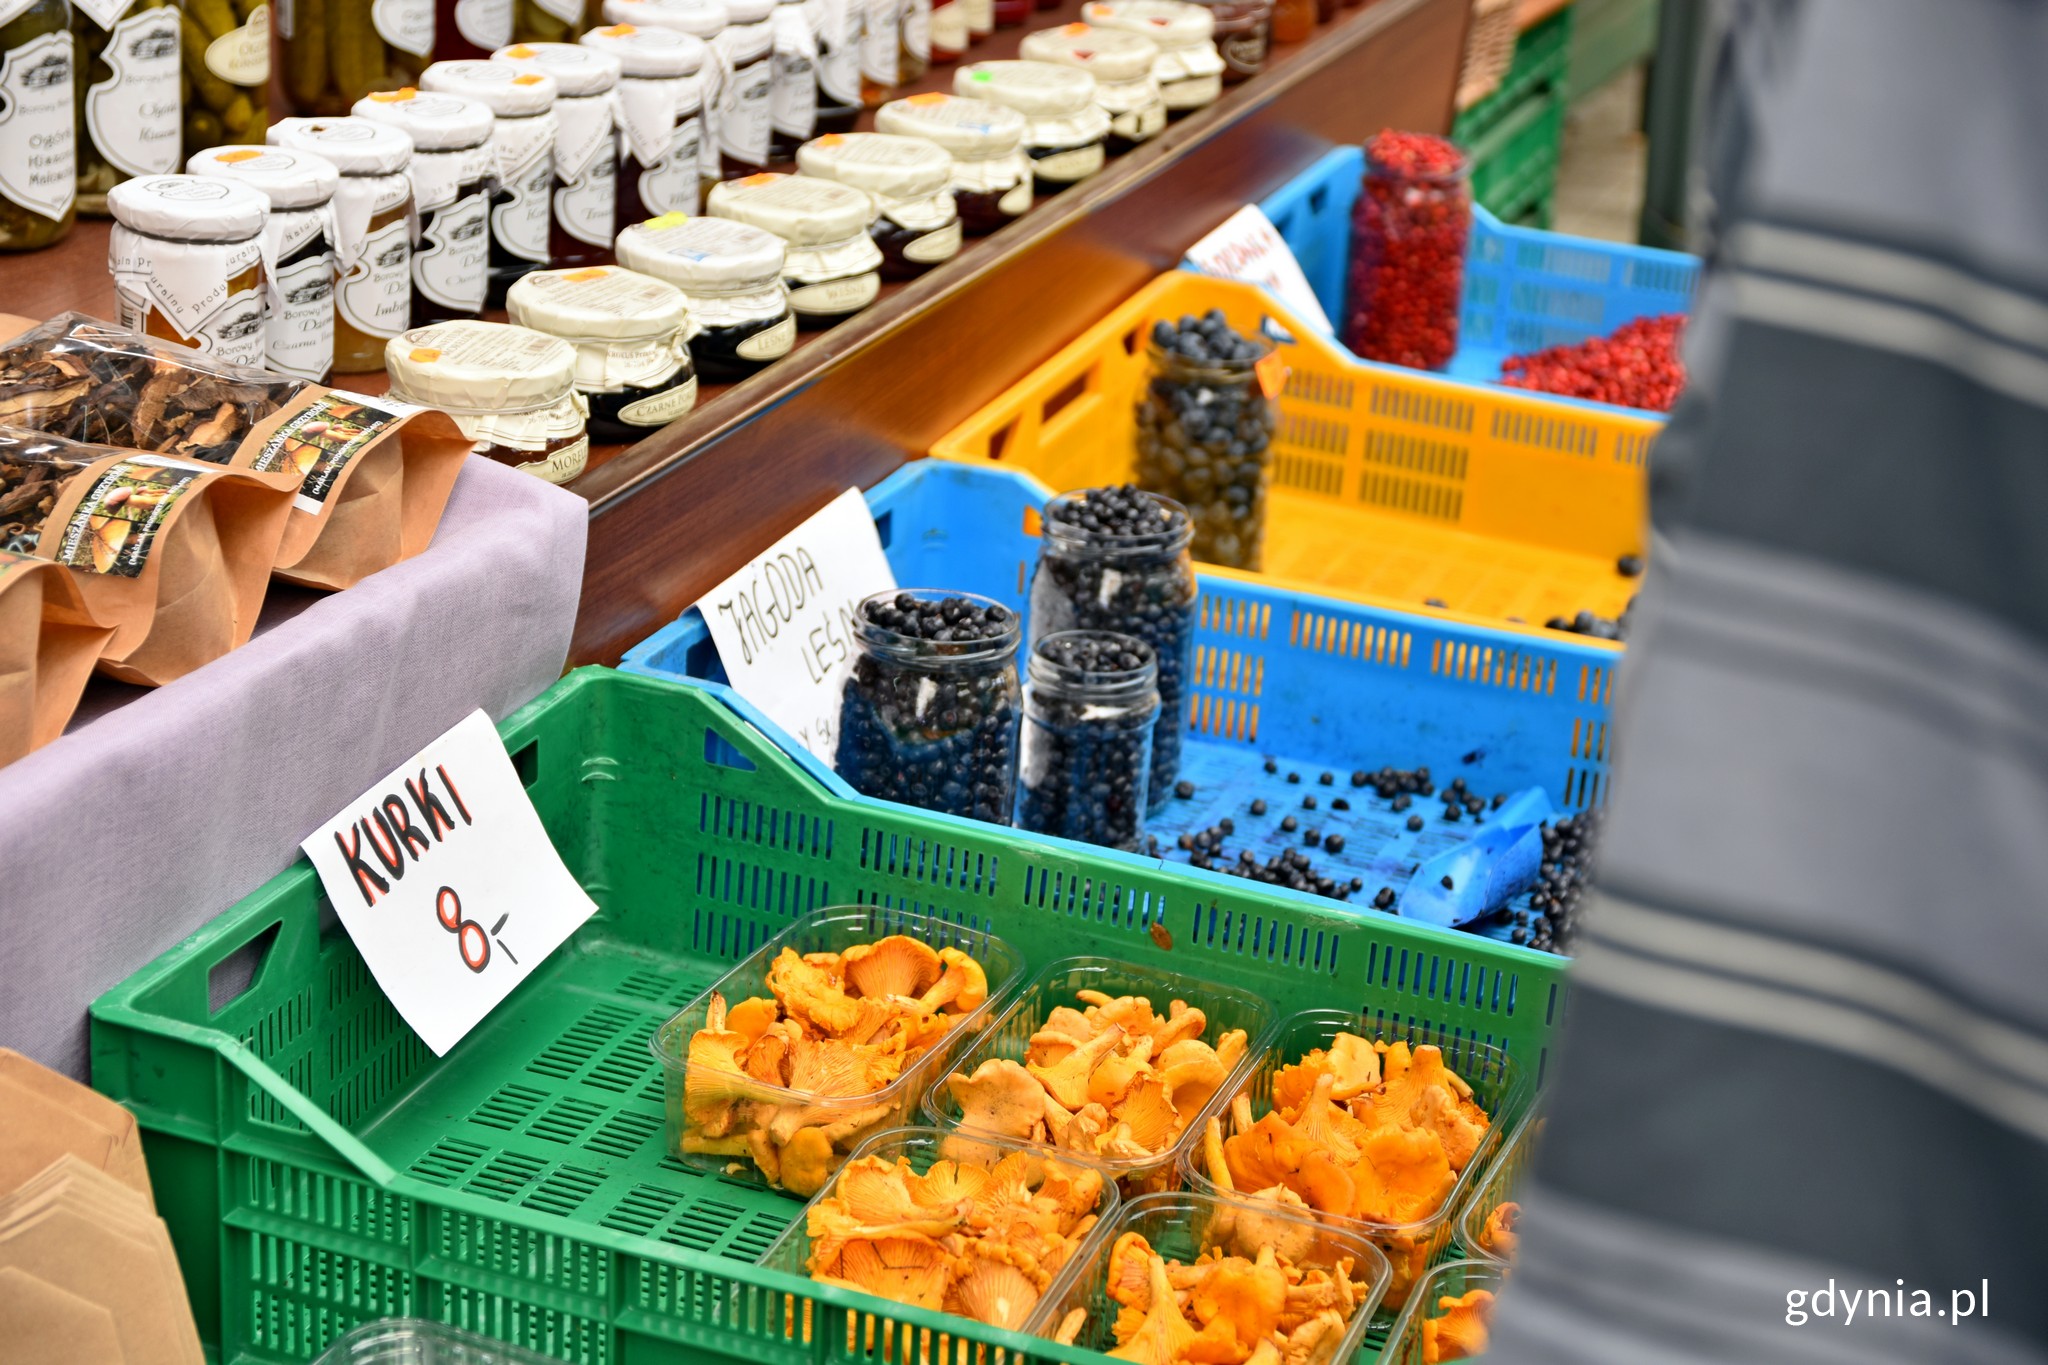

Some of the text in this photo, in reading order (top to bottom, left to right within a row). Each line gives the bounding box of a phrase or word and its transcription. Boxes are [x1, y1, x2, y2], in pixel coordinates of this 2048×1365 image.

[253, 424, 294, 472] MIESZANKA
[62, 500, 99, 561] MIESZANKA
[717, 546, 824, 665] JAGODA
[334, 763, 473, 908] KURKI
